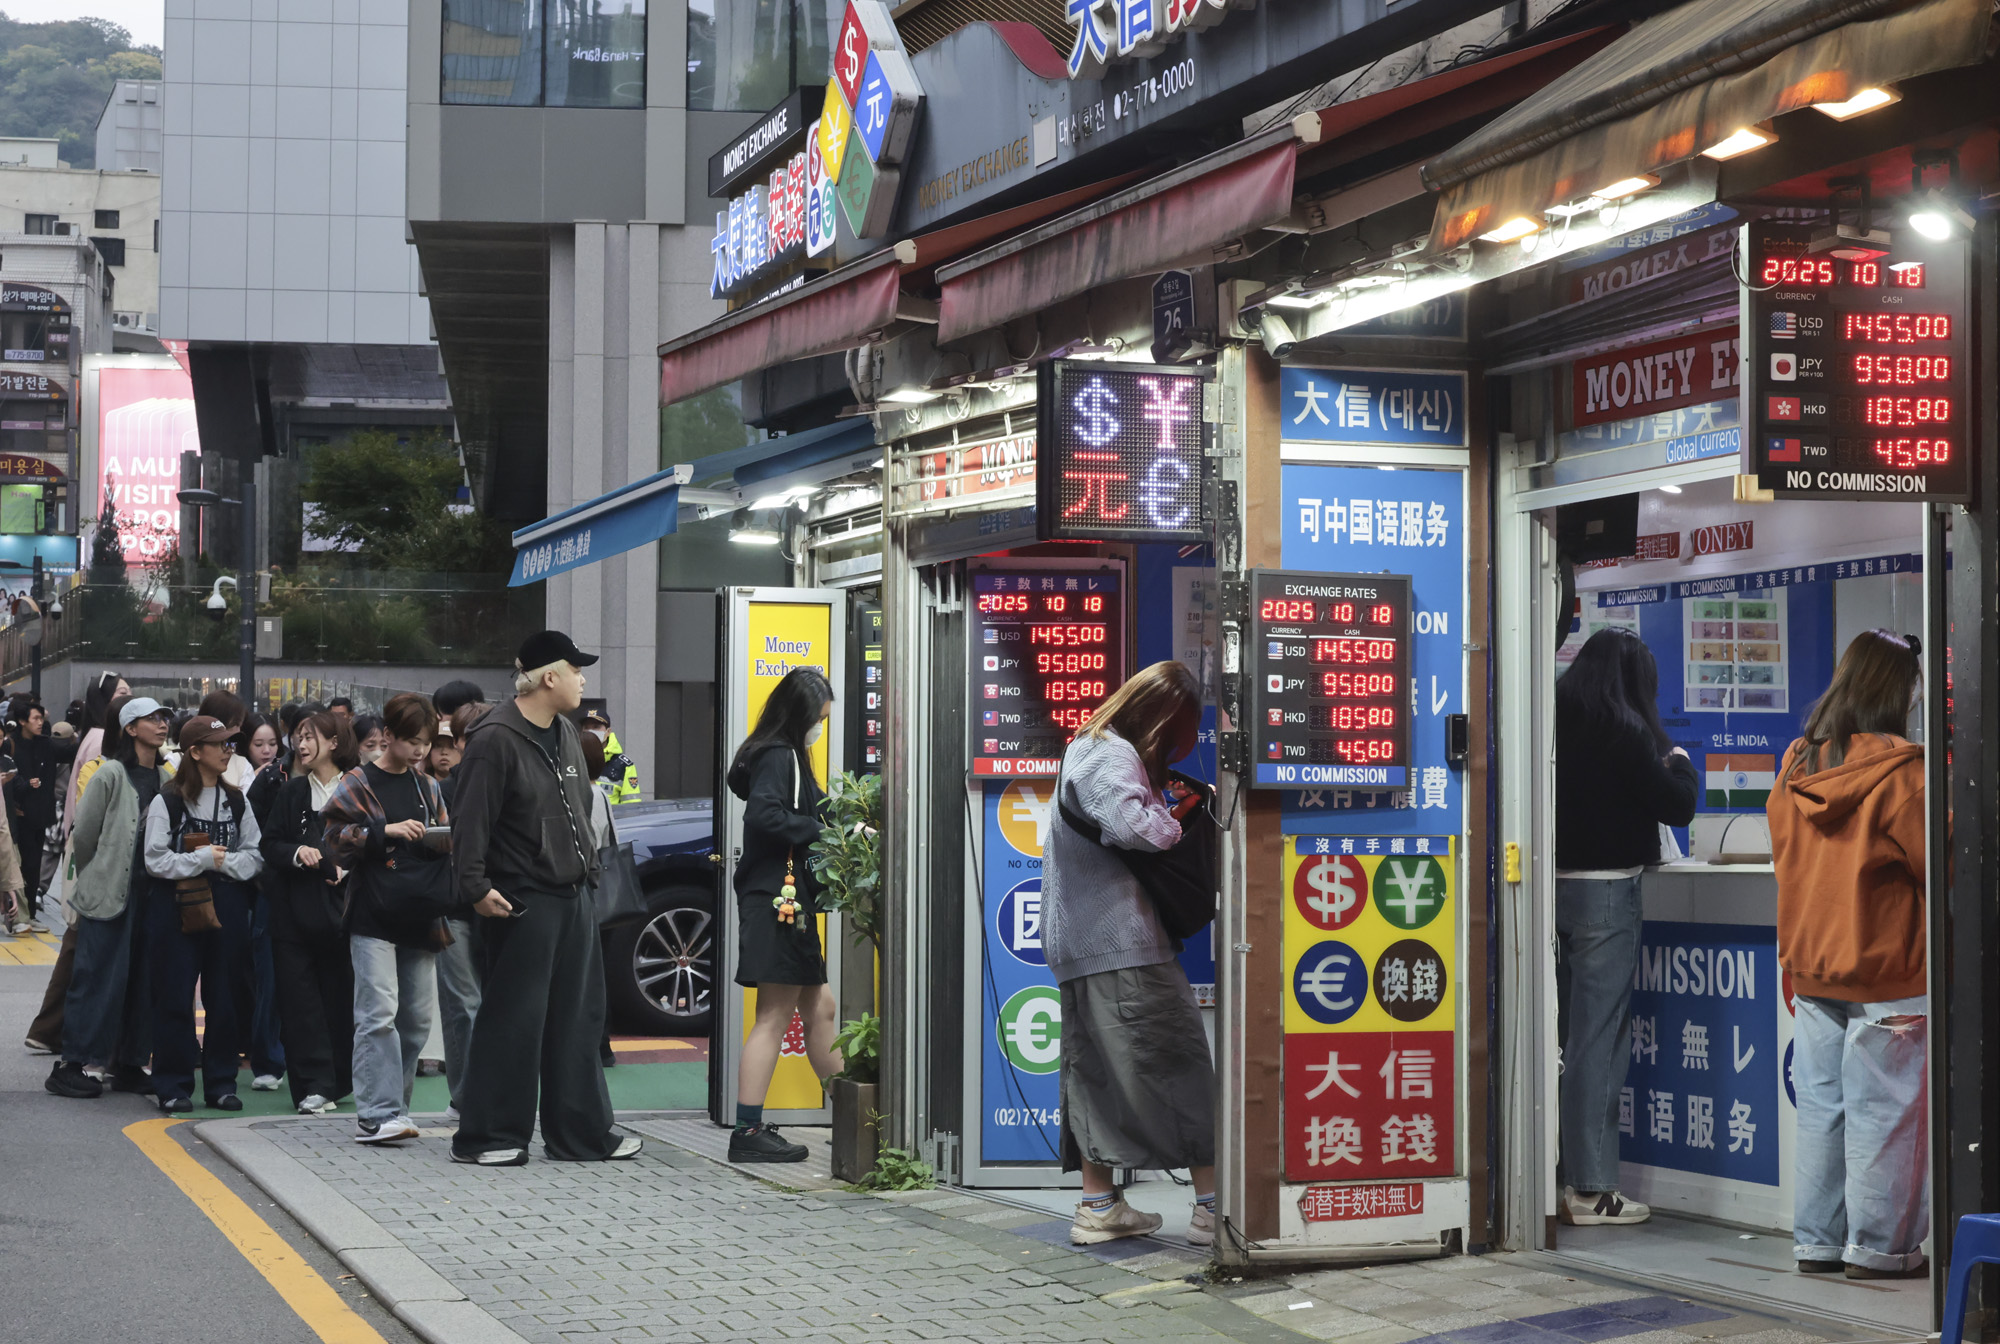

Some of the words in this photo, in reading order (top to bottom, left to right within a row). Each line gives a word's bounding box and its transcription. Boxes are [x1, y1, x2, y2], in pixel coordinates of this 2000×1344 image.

[723, 137, 751, 178] MONEY
[749, 108, 788, 158] EXCHANGE
[919, 171, 959, 209] MONEY
[962, 136, 1029, 192] EXCHANGE
[1764, 259, 1832, 283] 2025
[1853, 263, 1877, 284] 10
[1898, 264, 1921, 286] 18
[2, 290, 19, 302] 상가
[1776, 292, 1816, 301] CURRENCY
[1882, 296, 1903, 304] CASH
[1799, 317, 1823, 328] USD
[1799, 358, 1823, 370] JPY
[0, 376, 49, 390] 가발전문
[1585, 347, 1696, 413] MONEY
[1293, 381, 1372, 428] 大信
[1378, 387, 1453, 433] (대신)
[1803, 405, 1826, 414] HKD
[1666, 435, 1698, 462] Global
[1700, 427, 1741, 452] currency
[1803, 446, 1827, 456] TWD
[0, 458, 45, 475] 미용실
[104, 456, 123, 476] A
[130, 457, 181, 477] MU
[980, 438, 1036, 486] MONE
[1786, 471, 1812, 489] NO
[1817, 472, 1927, 493] COMMISSION
[1298, 497, 1450, 547] 可中国语服务
[1694, 522, 1752, 554] ONEY
[1285, 585, 1342, 597] EXCHANGE
[1344, 587, 1377, 599] RATES
[1679, 583, 1690, 596] NO
[1692, 577, 1736, 595] COMMISSION
[979, 595, 1028, 612] 2025
[1046, 596, 1065, 611] 10
[1084, 596, 1102, 612] 18
[1606, 593, 1616, 606] NO
[1617, 589, 1658, 605] COMMISSION
[1262, 601, 1314, 620] 2025
[1334, 604, 1353, 622] 10
[1373, 606, 1392, 624] 18
[1000, 632, 1021, 641] USD
[1271, 627, 1302, 635] CURRENCY
[765, 636, 812, 657] Money
[1285, 646, 1306, 657] USD
[1001, 659, 1020, 668] JPY
[1000, 687, 1021, 696] HKD
[1285, 680, 1305, 690] JPY
[1000, 714, 1021, 723] TWD
[1052, 709, 1098, 728] 45.6
[1284, 712, 1306, 723] HKD
[999, 741, 1020, 750] CNY
[1712, 734, 1734, 747] 인도
[1737, 735, 1768, 747] INDIA
[1284, 745, 1306, 756] TWD
[993, 760, 1011, 773] NO
[1277, 766, 1296, 781] NO
[1301, 766, 1387, 783] COMMISSION
[1315, 837, 1431, 854] 沒有手續費
[1008, 860, 1022, 868] NO
[1382, 957, 1439, 1004] 換錢
[1634, 944, 1756, 1000] MISSION
[1304, 1050, 1436, 1100] 大信
[1304, 1113, 1439, 1167] 換錢
